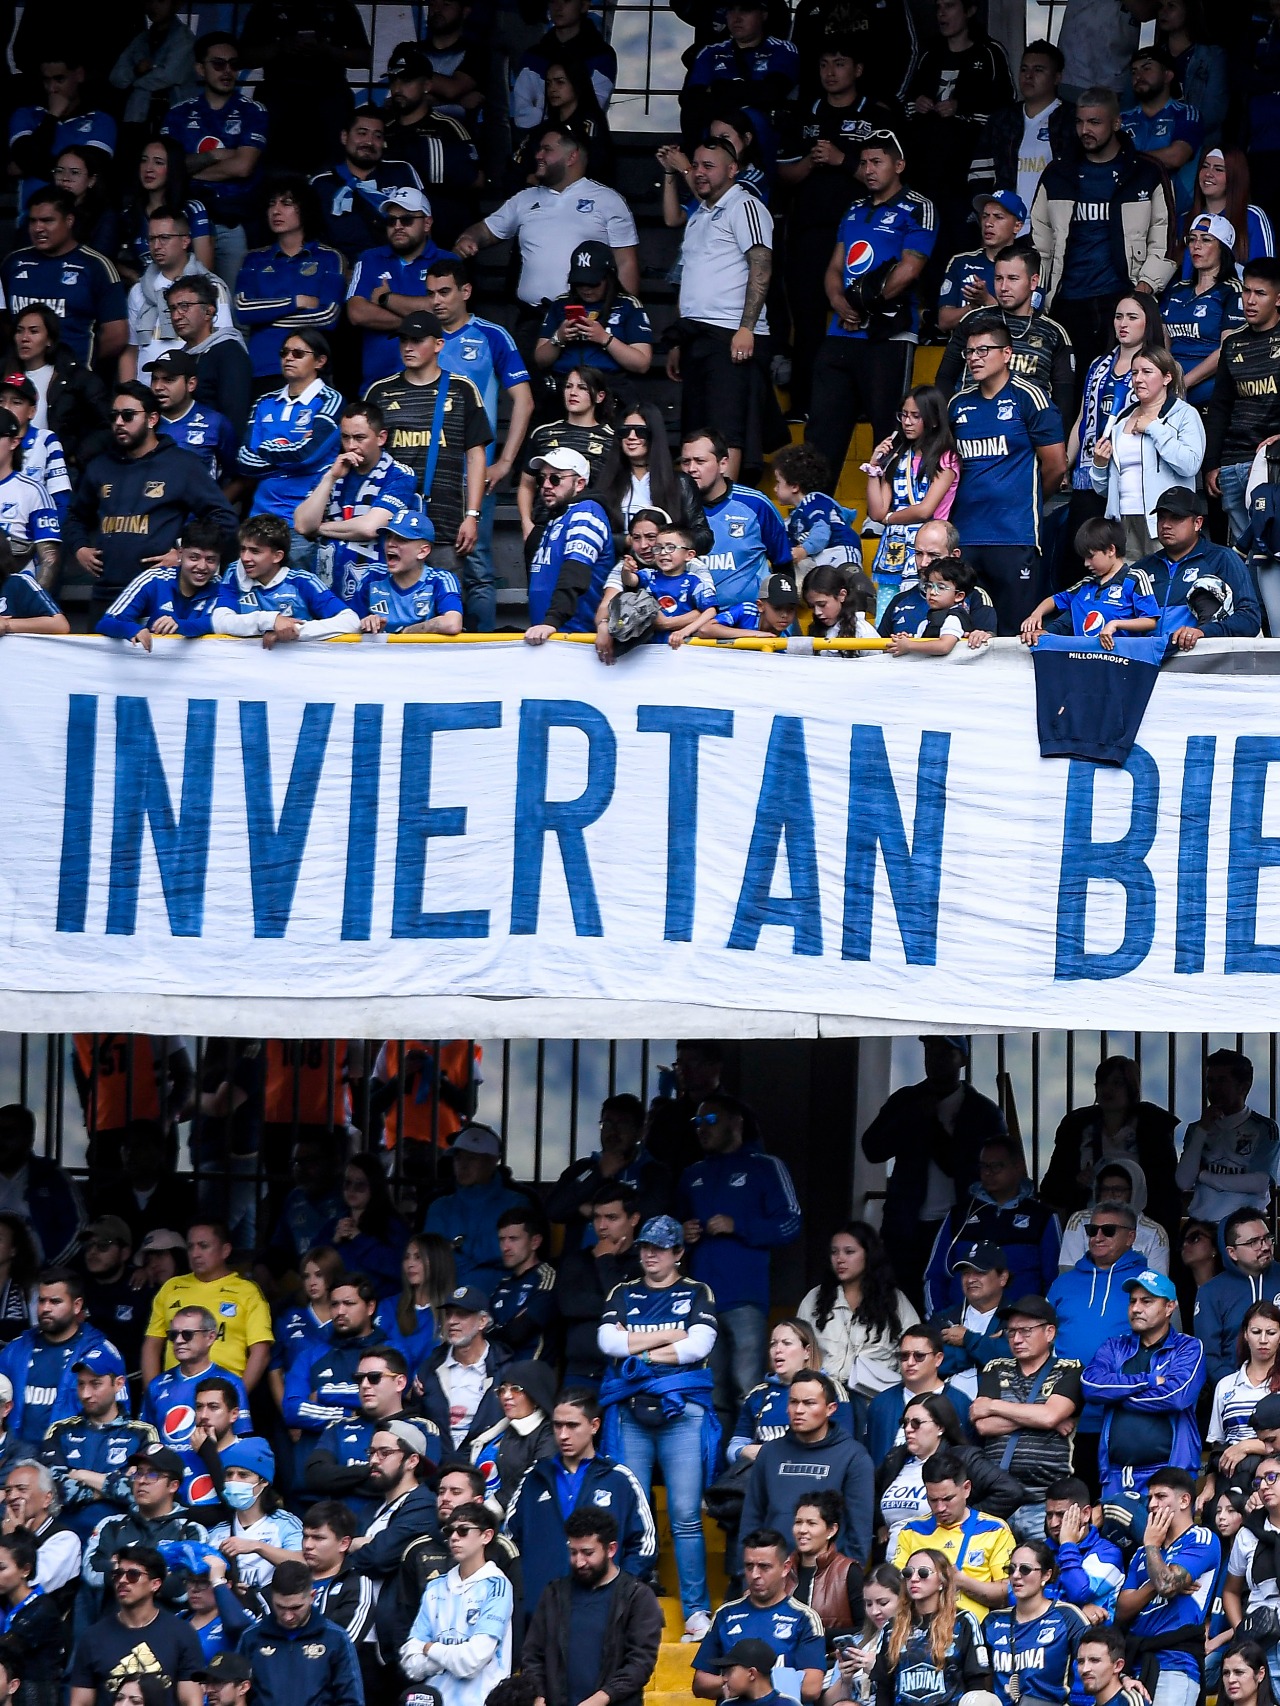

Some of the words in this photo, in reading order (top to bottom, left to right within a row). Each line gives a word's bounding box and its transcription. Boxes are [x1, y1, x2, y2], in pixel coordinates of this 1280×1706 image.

[1017, 157, 1046, 173] DINA
[1073, 202, 1109, 221] NDI
[577, 252, 591, 267] NY
[12, 295, 65, 318] ANNA
[1009, 353, 1038, 374] INA
[957, 434, 1009, 459] ANDINA
[37, 516, 60, 533] tig
[700, 551, 736, 571] DINA
[780, 579, 792, 592] LA
[1069, 652, 1130, 667] MILLONARIOSFC
[54, 693, 952, 967] INVIERTAN
[25, 1385, 57, 1406] NDI
[756, 1425, 790, 1442] AND
[884, 1485, 927, 1500] EON
[882, 1500, 918, 1510] CERVEZA
[993, 1647, 1045, 1673] ANDINA
[901, 1670, 946, 1693] ANDINA
